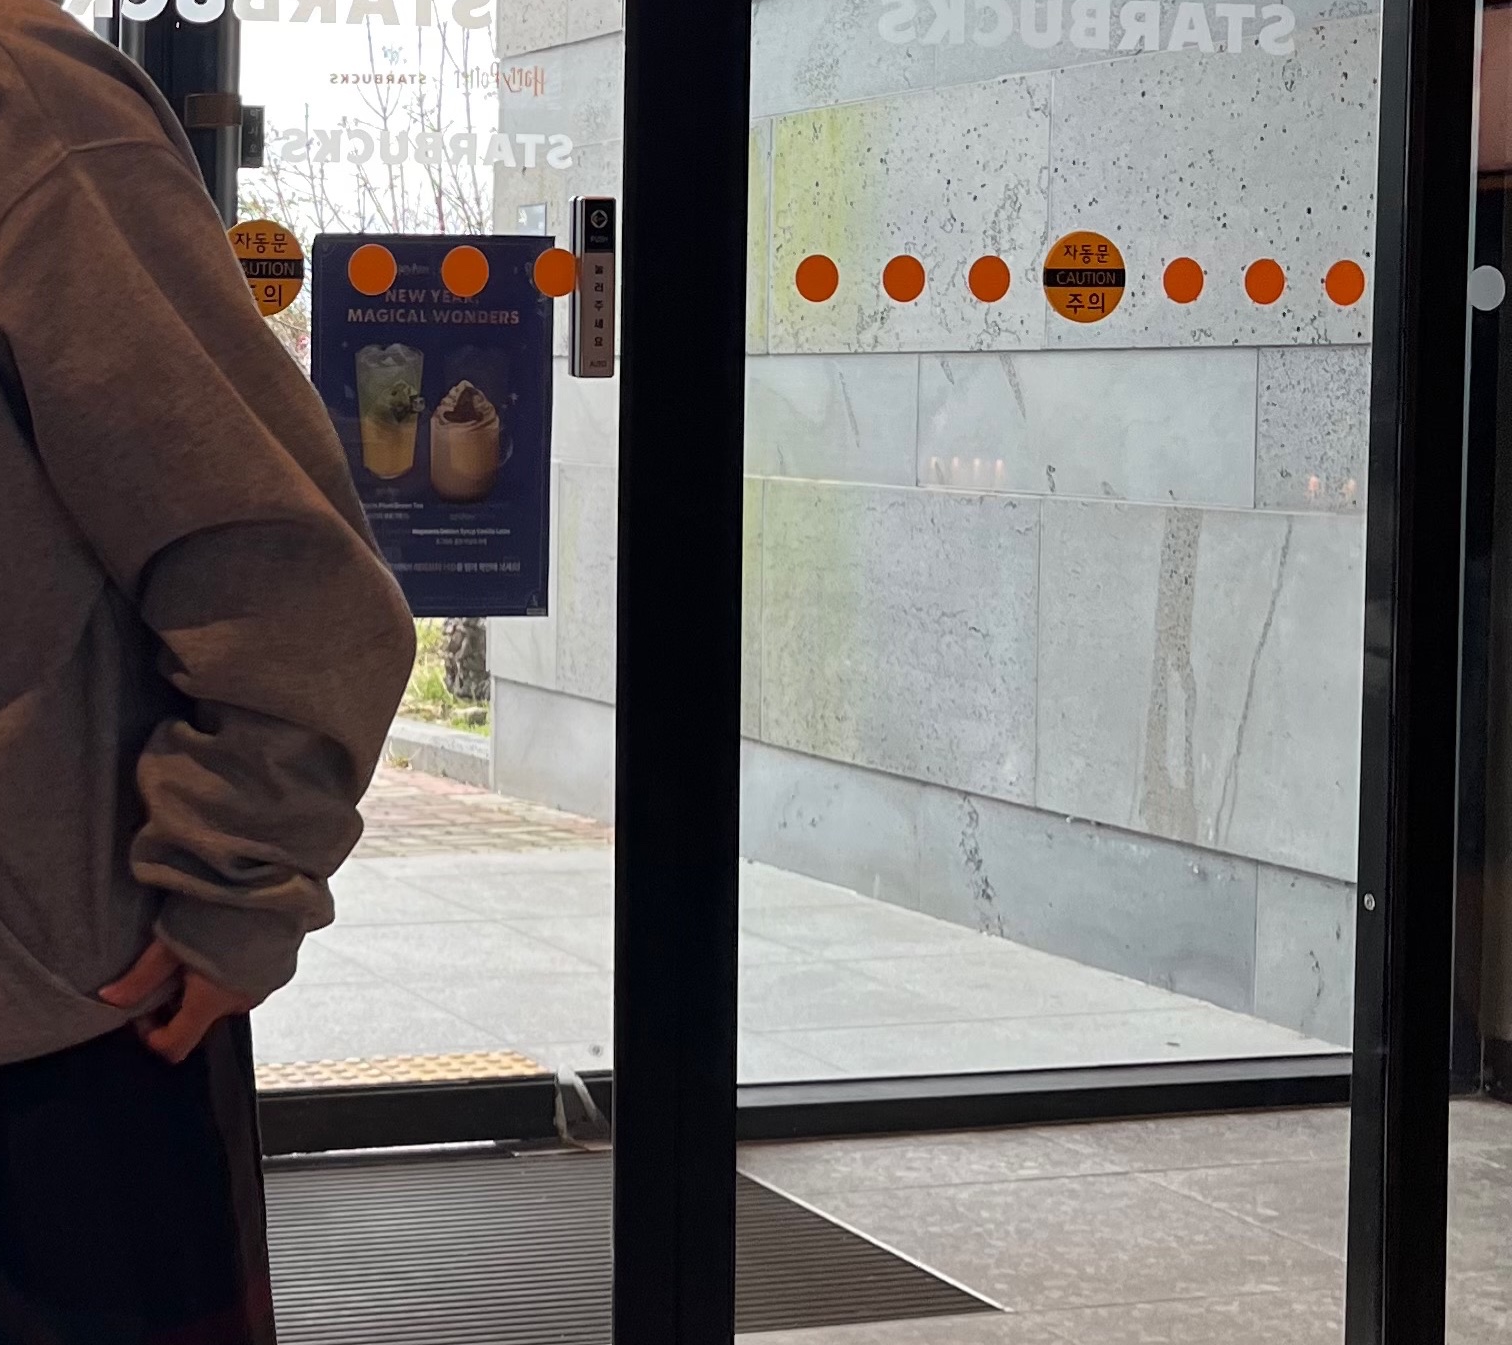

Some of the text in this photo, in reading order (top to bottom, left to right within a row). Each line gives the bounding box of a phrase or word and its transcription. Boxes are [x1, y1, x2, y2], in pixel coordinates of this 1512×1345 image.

[234, 232, 288, 253] 자동문
[1063, 242, 1111, 265] 자동문
[242, 261, 295, 276] AUTION
[1055, 269, 1116, 286] CAUTION
[385, 289, 424, 303] NEW
[1065, 291, 1107, 315] 주의
[347, 308, 520, 325] MAGICAL WONDERS
